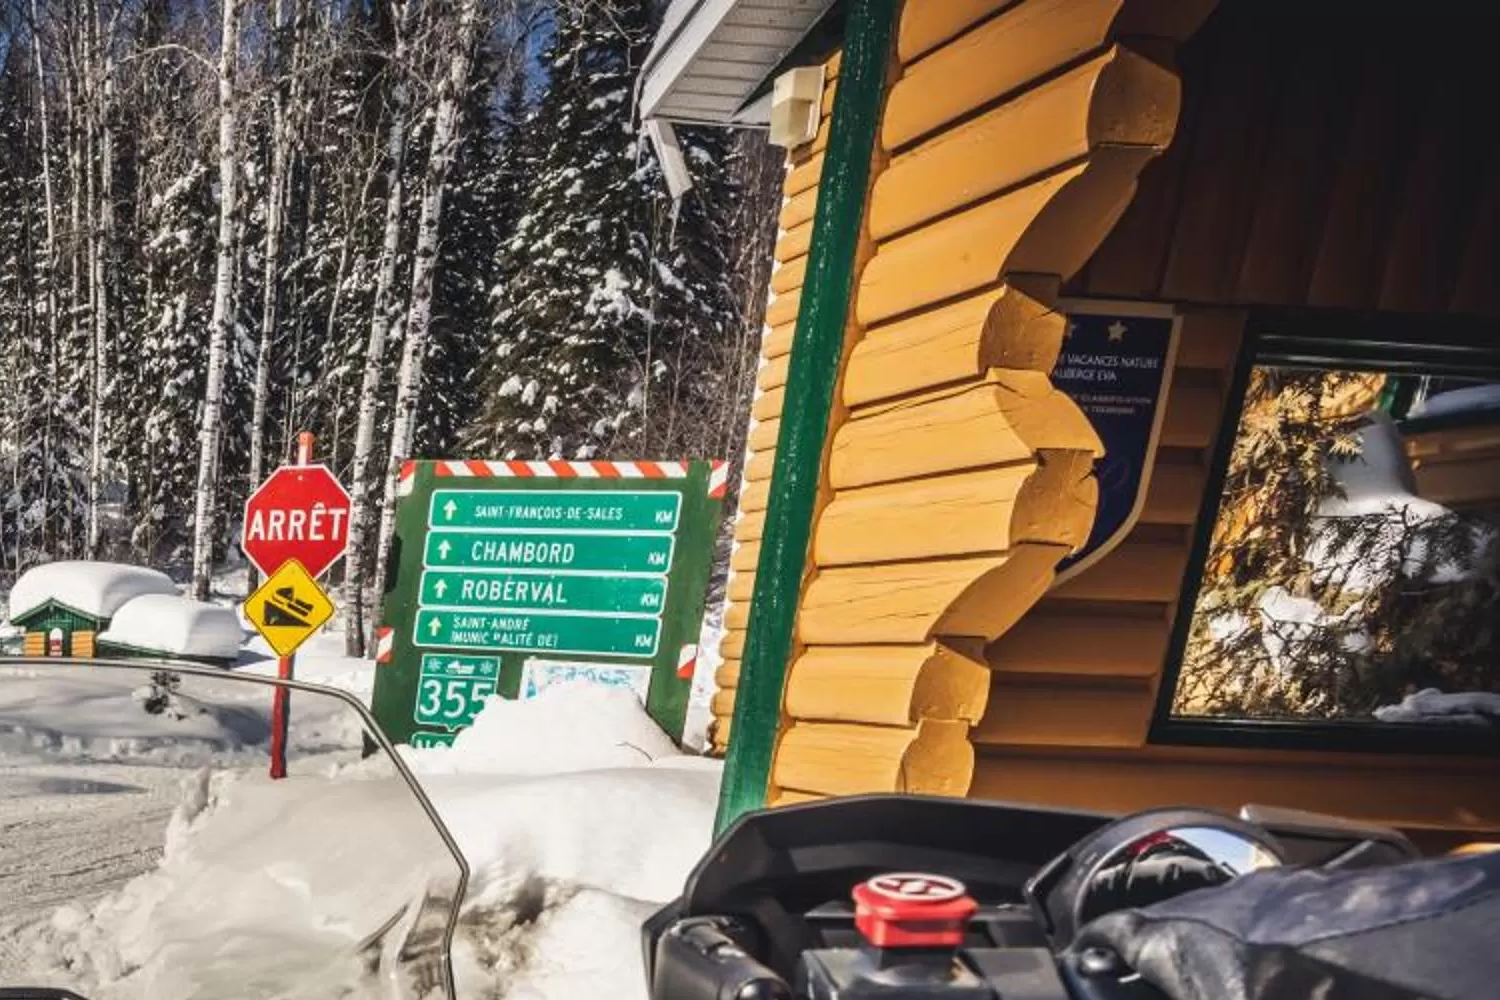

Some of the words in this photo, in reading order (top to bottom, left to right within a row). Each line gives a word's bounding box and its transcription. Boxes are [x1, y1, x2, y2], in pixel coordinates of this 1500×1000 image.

[247, 501, 347, 541] ARRÊT
[654, 510, 674, 524] KM
[470, 540, 576, 564] CHAMBORD
[647, 551, 667, 566] KM
[461, 578, 569, 604] ROBERVAL
[640, 593, 660, 607] KM
[452, 615, 532, 631] SAINT-ANDRÉ
[634, 634, 653, 648] KM
[418, 679, 493, 718] 355
